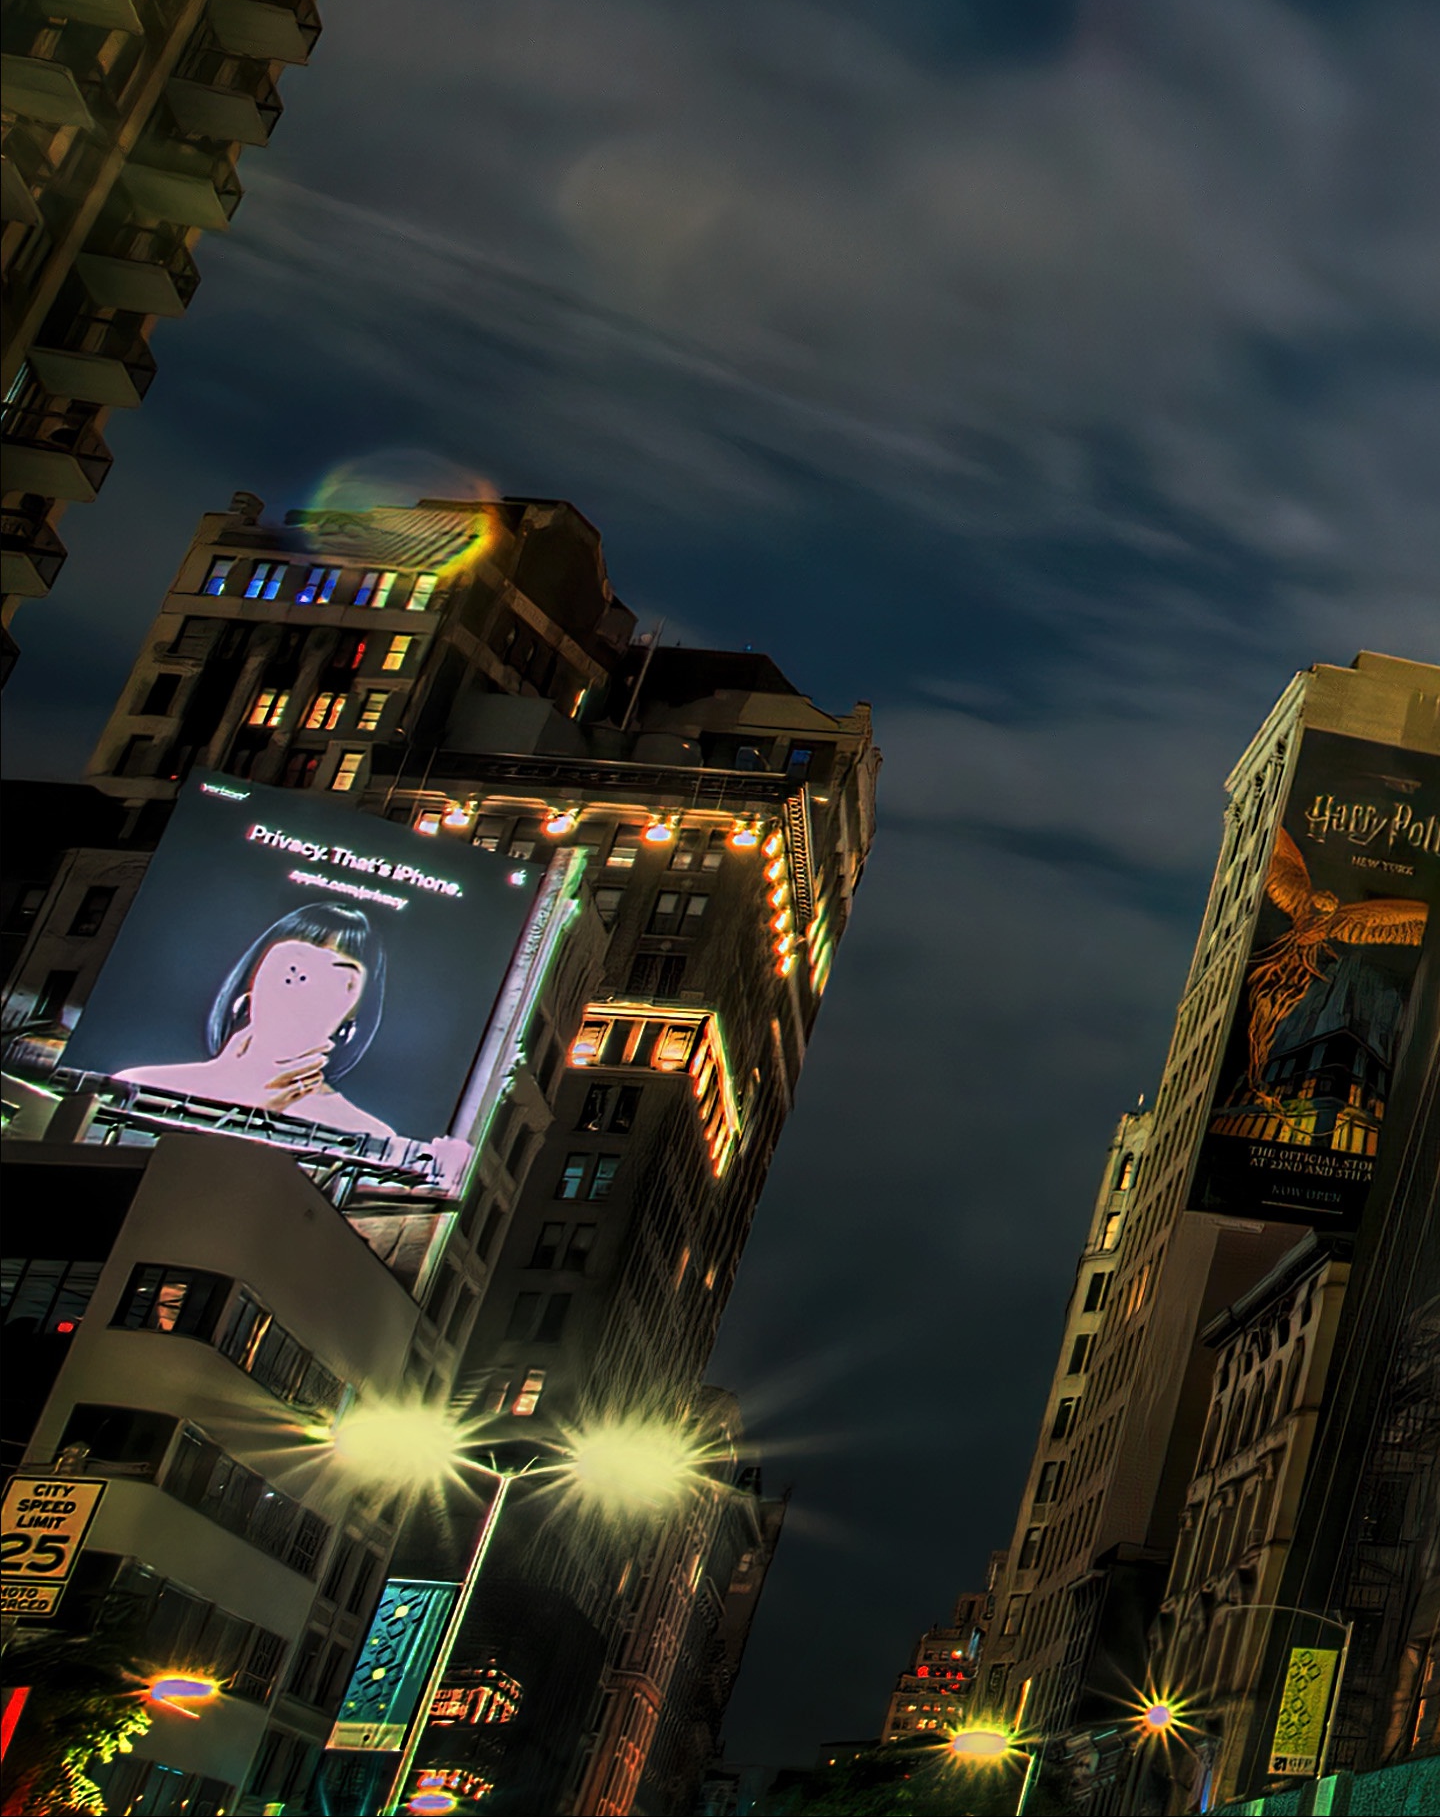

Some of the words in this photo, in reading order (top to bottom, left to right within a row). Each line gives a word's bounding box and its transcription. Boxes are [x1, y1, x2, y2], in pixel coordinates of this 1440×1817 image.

[1305, 794, 1388, 845] Harry
[248, 824, 328, 860] Privacy.
[329, 847, 392, 877] That's
[393, 863, 463, 897] iPhone.
[1352, 855, 1380, 869] NEW
[1382, 860, 1414, 876] YORK
[1249, 1145, 1276, 1158] THE
[1279, 1150, 1339, 1168] OFFICIAL
[1250, 1157, 1266, 1168] AT
[1270, 1159, 1302, 1172] 22ND
[1304, 1164, 1333, 1177] AND
[33, 1483, 76, 1498] CITY
[17, 1498, 77, 1514] SPEED
[16, 1514, 67, 1530] LIMIT
[1, 1532, 71, 1573] 25
